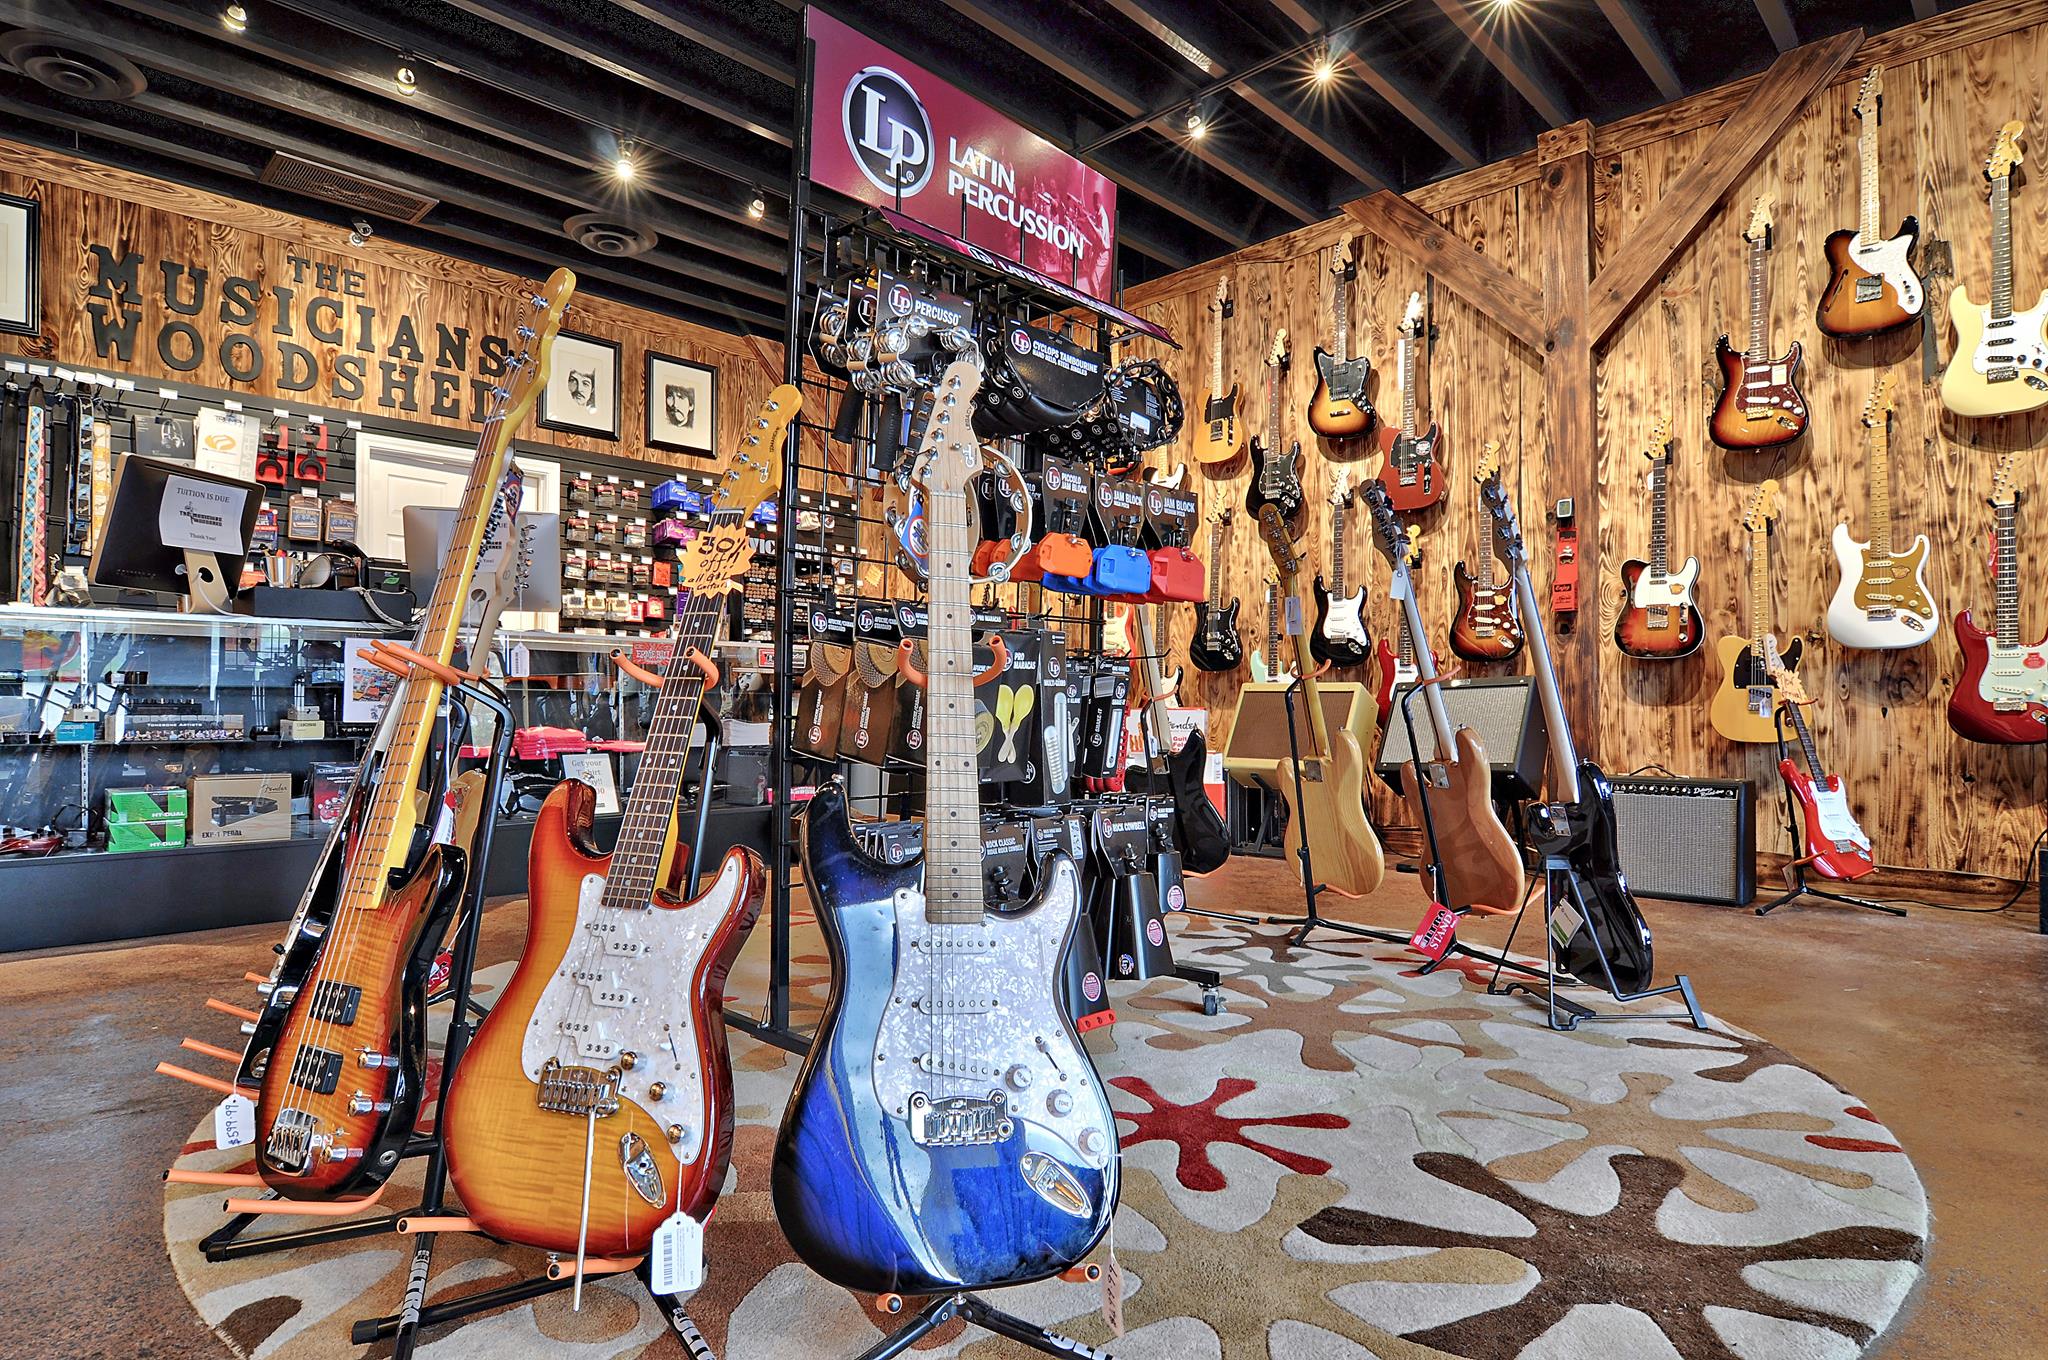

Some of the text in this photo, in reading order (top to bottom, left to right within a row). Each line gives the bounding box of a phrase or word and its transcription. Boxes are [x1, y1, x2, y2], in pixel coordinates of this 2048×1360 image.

[858, 83, 926, 184] LP
[949, 135, 1016, 195] LATIN
[948, 169, 1086, 260] PERCUSSION
[287, 255, 367, 299] THE
[891, 287, 911, 314] LP
[88, 243, 509, 378] MUSICIANS
[914, 299, 960, 327] PERCUSSO
[1014, 332, 1031, 353] LP
[1033, 340, 1098, 374] CYCLOPS TAMBOURINE
[964, 405, 973, 431] LEGACY
[1048, 467, 1060, 489] LP
[1061, 471, 1081, 483] PICCOLO
[177, 487, 231, 504] TUITION IS DUE
[1061, 482, 1088, 494] JAM BLOCK
[1100, 484, 1112, 506] LP
[1114, 490, 1125, 502] JAM
[1125, 492, 1142, 505] BLOCK
[1151, 491, 1162, 514] LP
[1163, 497, 1175, 509] JAM
[1176, 499, 1196, 513] BLOCK
[189, 532, 205, 540] Thank
[698, 535, 746, 558] 30%
[749, 537, 776, 555] VIC
[700, 552, 740, 572] off!!
[688, 573, 705, 583] all
[814, 613, 827, 630] LP
[860, 611, 872, 629] LP
[901, 608, 915, 626] LP
[1013, 660, 1036, 670] MARACAS
[1014, 651, 1025, 661] PRO
[1049, 657, 1060, 676] LP
[1168, 716, 1198, 730] ender
[585, 760, 602, 768] your
[262, 782, 288, 793] Fender
[222, 829, 243, 837] PEDAL
[1112, 820, 1146, 832] ROCK COWBELL
[1430, 913, 1453, 950] STAND
[225, 1104, 242, 1145] $599.99
